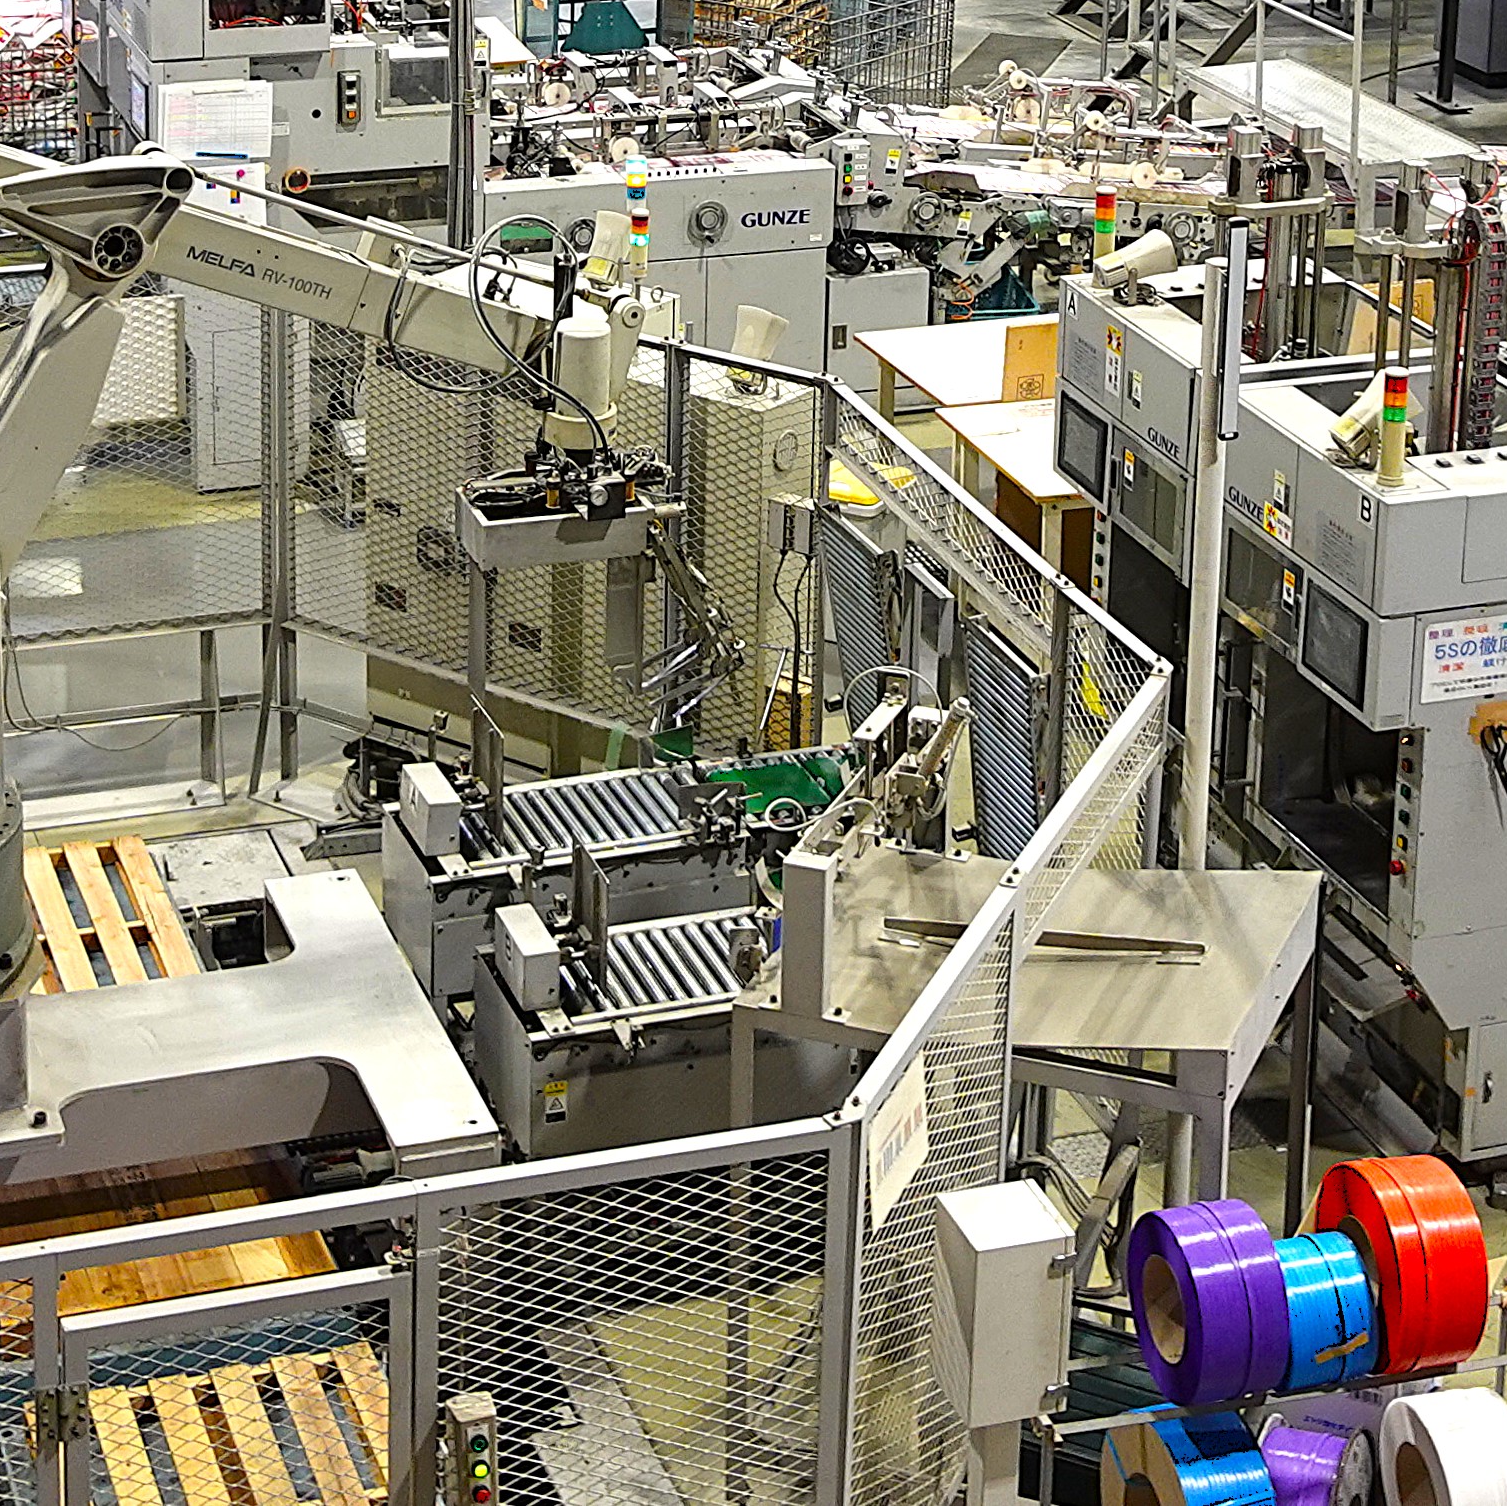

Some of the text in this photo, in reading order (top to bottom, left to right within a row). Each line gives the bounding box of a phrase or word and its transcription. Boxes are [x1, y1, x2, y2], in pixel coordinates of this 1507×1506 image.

[740, 209, 811, 228] GUNZE
[186, 245, 333, 300] MELFA RV-100TH
[1067, 292, 1076, 316] A
[1147, 426, 1180, 462] GUNZE
[1228, 485, 1264, 523] GUNZE
[1360, 494, 1372, 523] B
